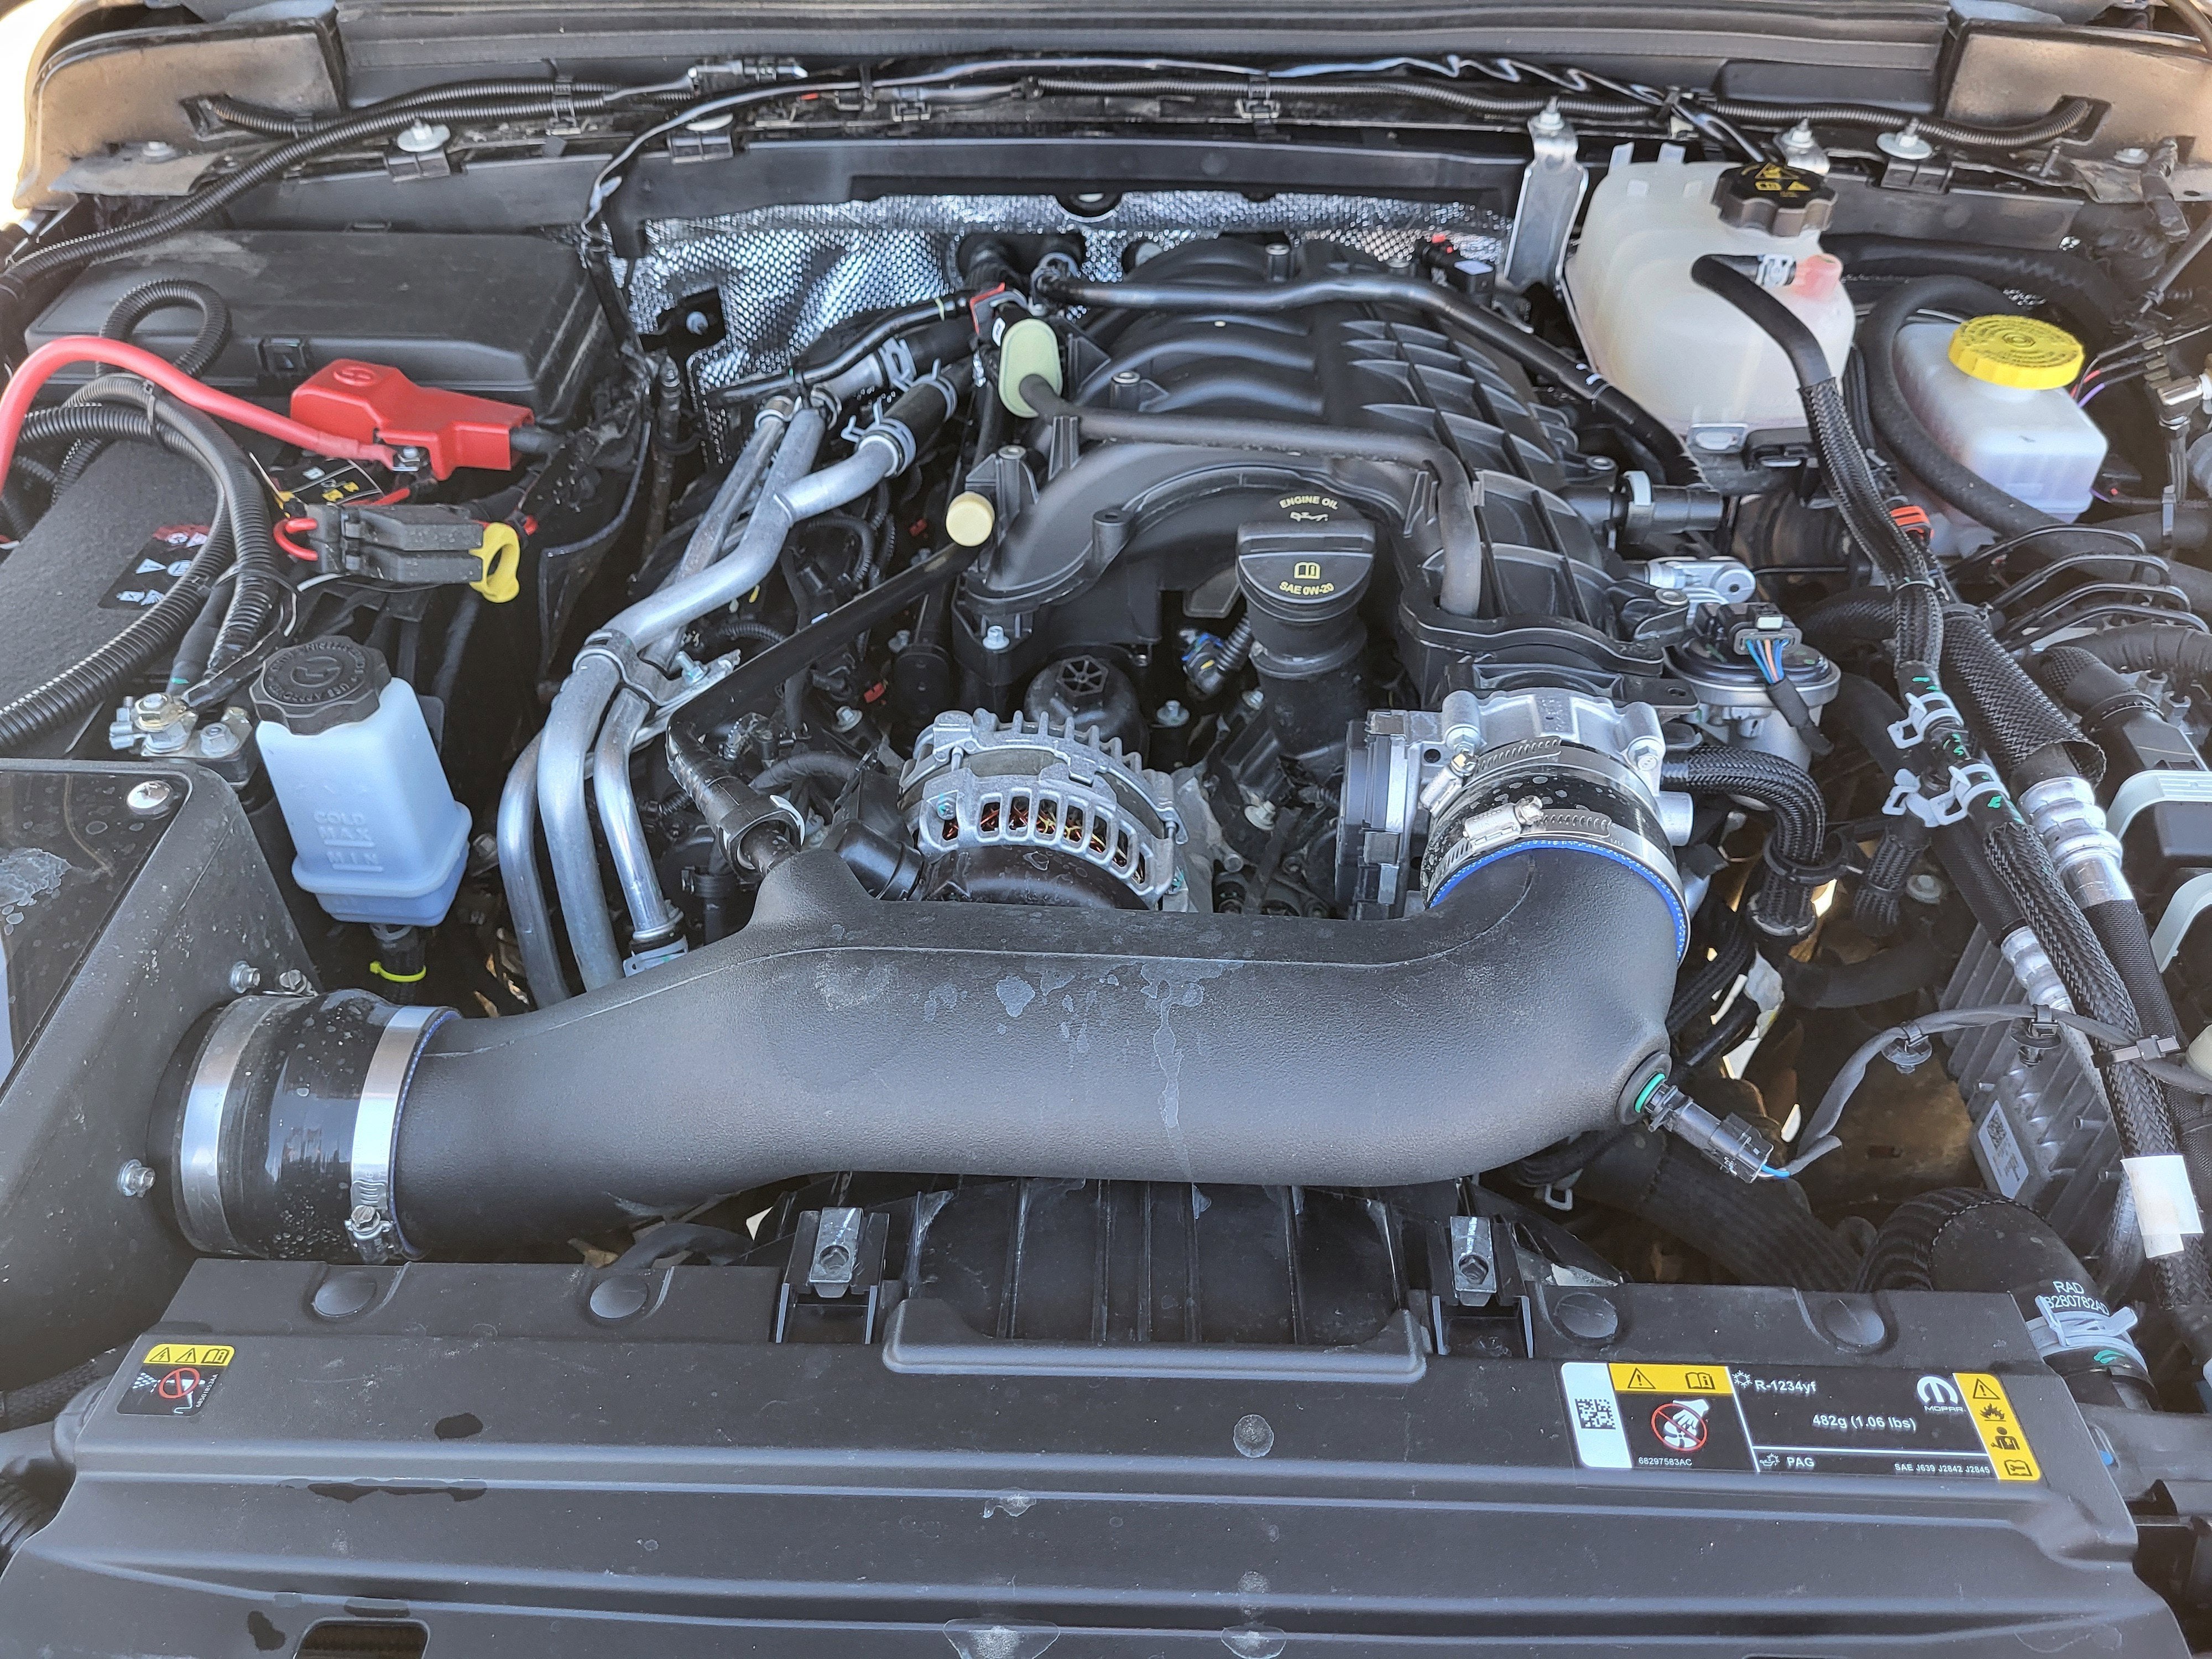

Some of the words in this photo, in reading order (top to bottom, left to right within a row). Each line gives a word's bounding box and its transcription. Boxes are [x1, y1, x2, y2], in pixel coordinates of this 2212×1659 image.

[1279, 495, 1320, 509] ENGINE
[1321, 498, 1338, 510] OIL
[1279, 581, 1302, 594] SAE
[1302, 582, 1334, 596] 0W-20
[314, 811, 364, 825] COLD
[317, 826, 372, 841] MAX
[326, 851, 379, 865] MIN
[2053, 1281, 2085, 1294] RAD
[1754, 1380, 1817, 1394] R-1234yf
[1813, 1414, 1848, 1429] 482g
[1850, 1415, 1885, 1430] (1.06
[1887, 1416, 1917, 1431] lbs)
[1786, 1457, 1815, 1467] PAG
[1894, 1463, 1914, 1472] SAE
[1916, 1464, 1936, 1472] J639
